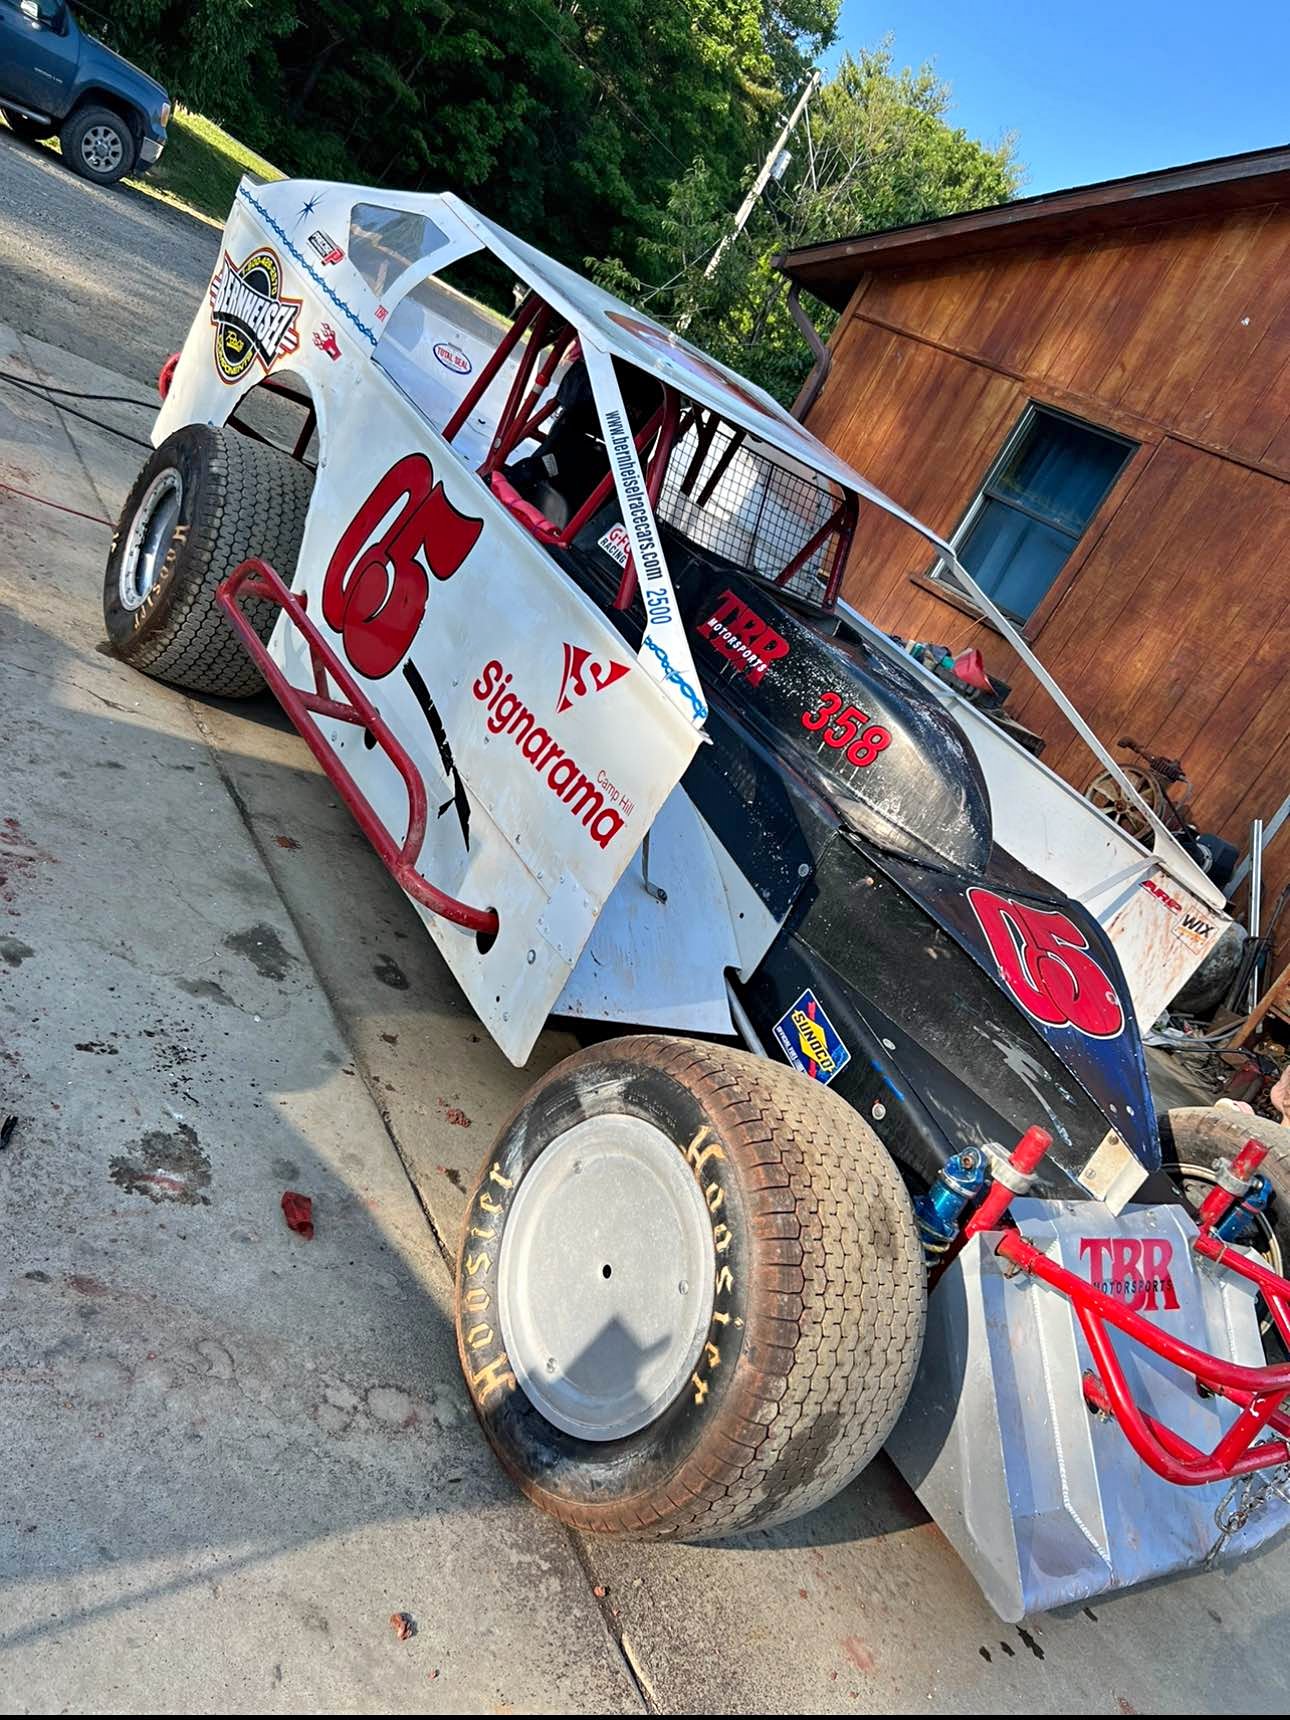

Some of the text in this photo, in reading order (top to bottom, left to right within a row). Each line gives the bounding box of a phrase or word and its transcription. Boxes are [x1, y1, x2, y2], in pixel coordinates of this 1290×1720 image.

[214, 262, 297, 358] BERNHEISEL
[437, 346, 453, 362] TOTAL
[455, 356, 468, 370] SEAL
[605, 410, 672, 625] www.bernheiselracecars.com 2500
[600, 538, 627, 563] RACING
[697, 588, 790, 688] TBR
[707, 618, 768, 672] MOTORSPORTS
[801, 692, 893, 767] 358
[597, 769, 635, 816] Camp Hill
[1139, 880, 1182, 913] ARP
[1182, 914, 1214, 938] WIX
[794, 1013, 833, 1069] SUNOCO
[465, 1161, 517, 1405] Hoosier
[680, 1125, 744, 1405] Hoosier
[1080, 1237, 1180, 1311] TBR
[1092, 1279, 1173, 1295] MOTORSPORTS
